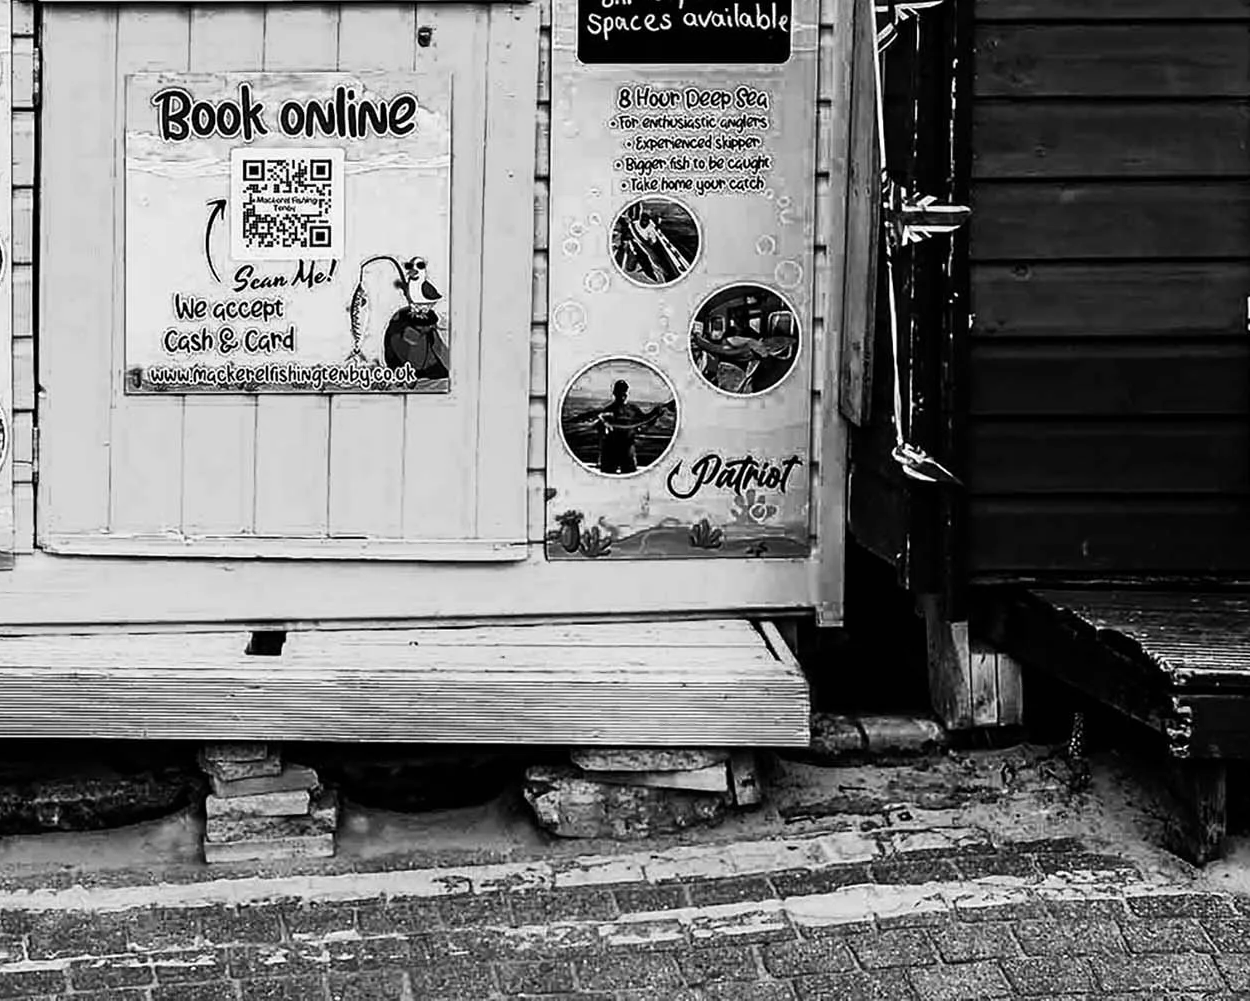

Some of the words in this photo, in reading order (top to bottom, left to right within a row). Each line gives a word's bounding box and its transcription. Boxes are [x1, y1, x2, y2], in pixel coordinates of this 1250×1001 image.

[587, 13, 673, 41] spaces
[683, 2, 790, 33] available
[618, 88, 632, 109] 8
[636, 88, 681, 108] Hour
[685, 88, 732, 111] Deep
[735, 87, 769, 109] Sea
[153, 83, 269, 142] Book
[279, 85, 418, 138] online
[618, 115, 639, 130] For
[642, 115, 717, 130] enthusiastic
[719, 115, 769, 133] anglers
[635, 135, 714, 151] Experienced
[716, 135, 762, 152] skipper
[625, 157, 667, 175] Bigger
[669, 156, 691, 171] fish
[727, 156, 771, 175] caught
[630, 176, 659, 192] Take
[661, 176, 694, 192] home
[696, 179, 727, 195] your
[729, 176, 766, 191] catch
[232, 264, 289, 293] Scan
[290, 259, 338, 288] Me!
[174, 293, 207, 320] We
[212, 297, 284, 322] accept
[163, 328, 213, 353] Cash
[219, 328, 239, 353] &
[244, 326, 296, 353] Card
[150, 365, 417, 389] www.mackerelfishingtenby.co.uk
[667, 454, 803, 499] Patriot
